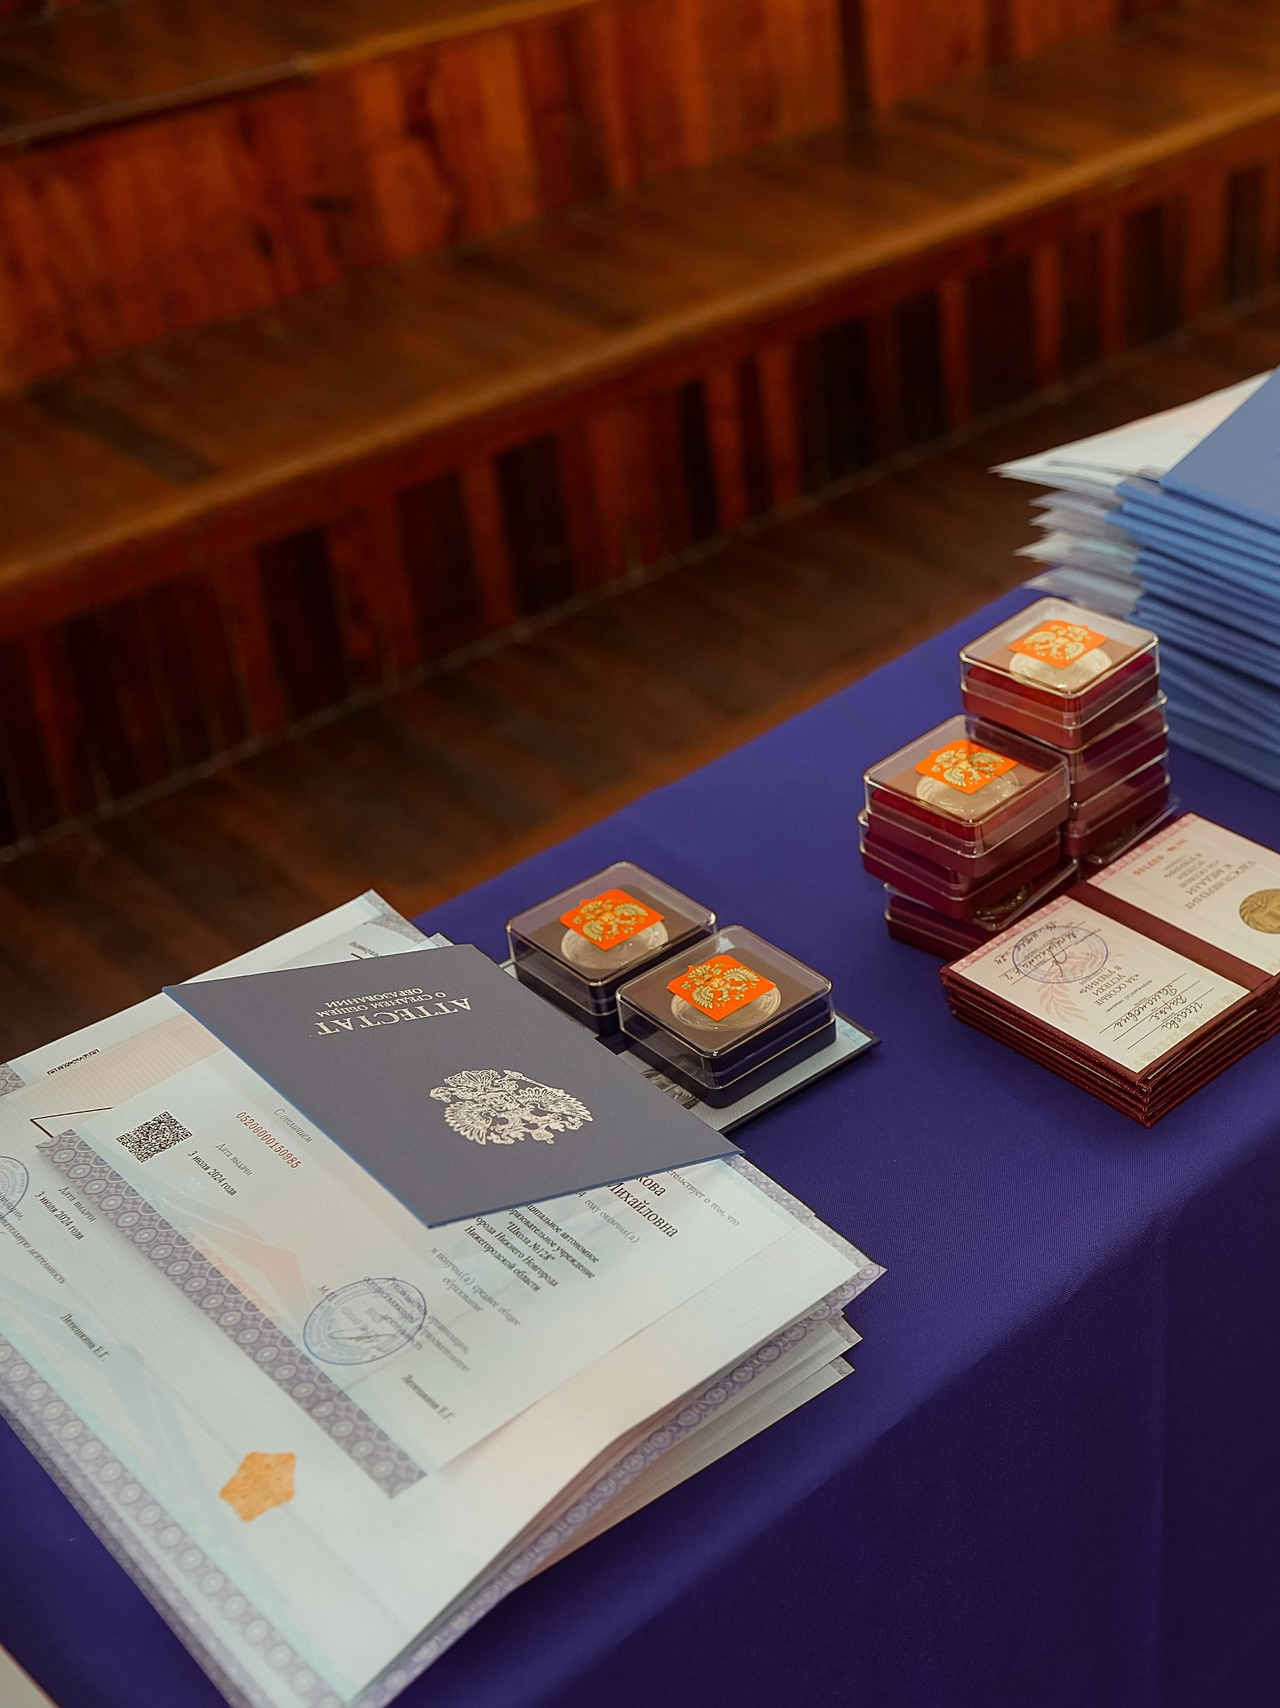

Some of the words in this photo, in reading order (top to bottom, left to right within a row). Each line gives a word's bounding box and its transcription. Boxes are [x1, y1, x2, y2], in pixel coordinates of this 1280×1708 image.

[323, 987, 424, 1008] ОБРАЗОВАНИИ
[371, 994, 434, 1009] СРЕДНЕМ
[1092, 973, 1126, 996] УСПЕХИ
[1094, 983, 1127, 1006] ОСОБЫЕ
[315, 997, 472, 1036] АТТЕСТАТ
[316, 1004, 369, 1018] ОБЩЕМ
[1160, 1002, 1202, 1031] Исаева
[236, 1111, 301, 1169] 05206000150985
[193, 1155, 211, 1172] июля
[207, 1169, 227, 1184] 2024
[220, 1181, 237, 1196] года
[215, 1142, 232, 1158] Дата
[231, 1155, 253, 1176] выдачи
[39, 1197, 58, 1214] июля
[54, 1211, 74, 1227] 2024
[68, 1225, 84, 1241] года
[58, 1186, 76, 1202] Дата
[74, 1200, 97, 1223] выдачи
[584, 1199, 601, 1214] году
[599, 1211, 641, 1244] окончил(а)
[710, 1202, 725, 1217] том,
[726, 1215, 740, 1227] что
[464, 1225, 517, 1270] Нижегородской
[513, 1268, 542, 1292] области
[474, 1217, 497, 1235] орода
[494, 1232, 525, 1259] Нижнего
[523, 1256, 559, 1287] Новгорода
[552, 1246, 595, 1279] учреждение
[560, 1231, 599, 1264] автономное
[28, 1248, 65, 1284] деятельность
